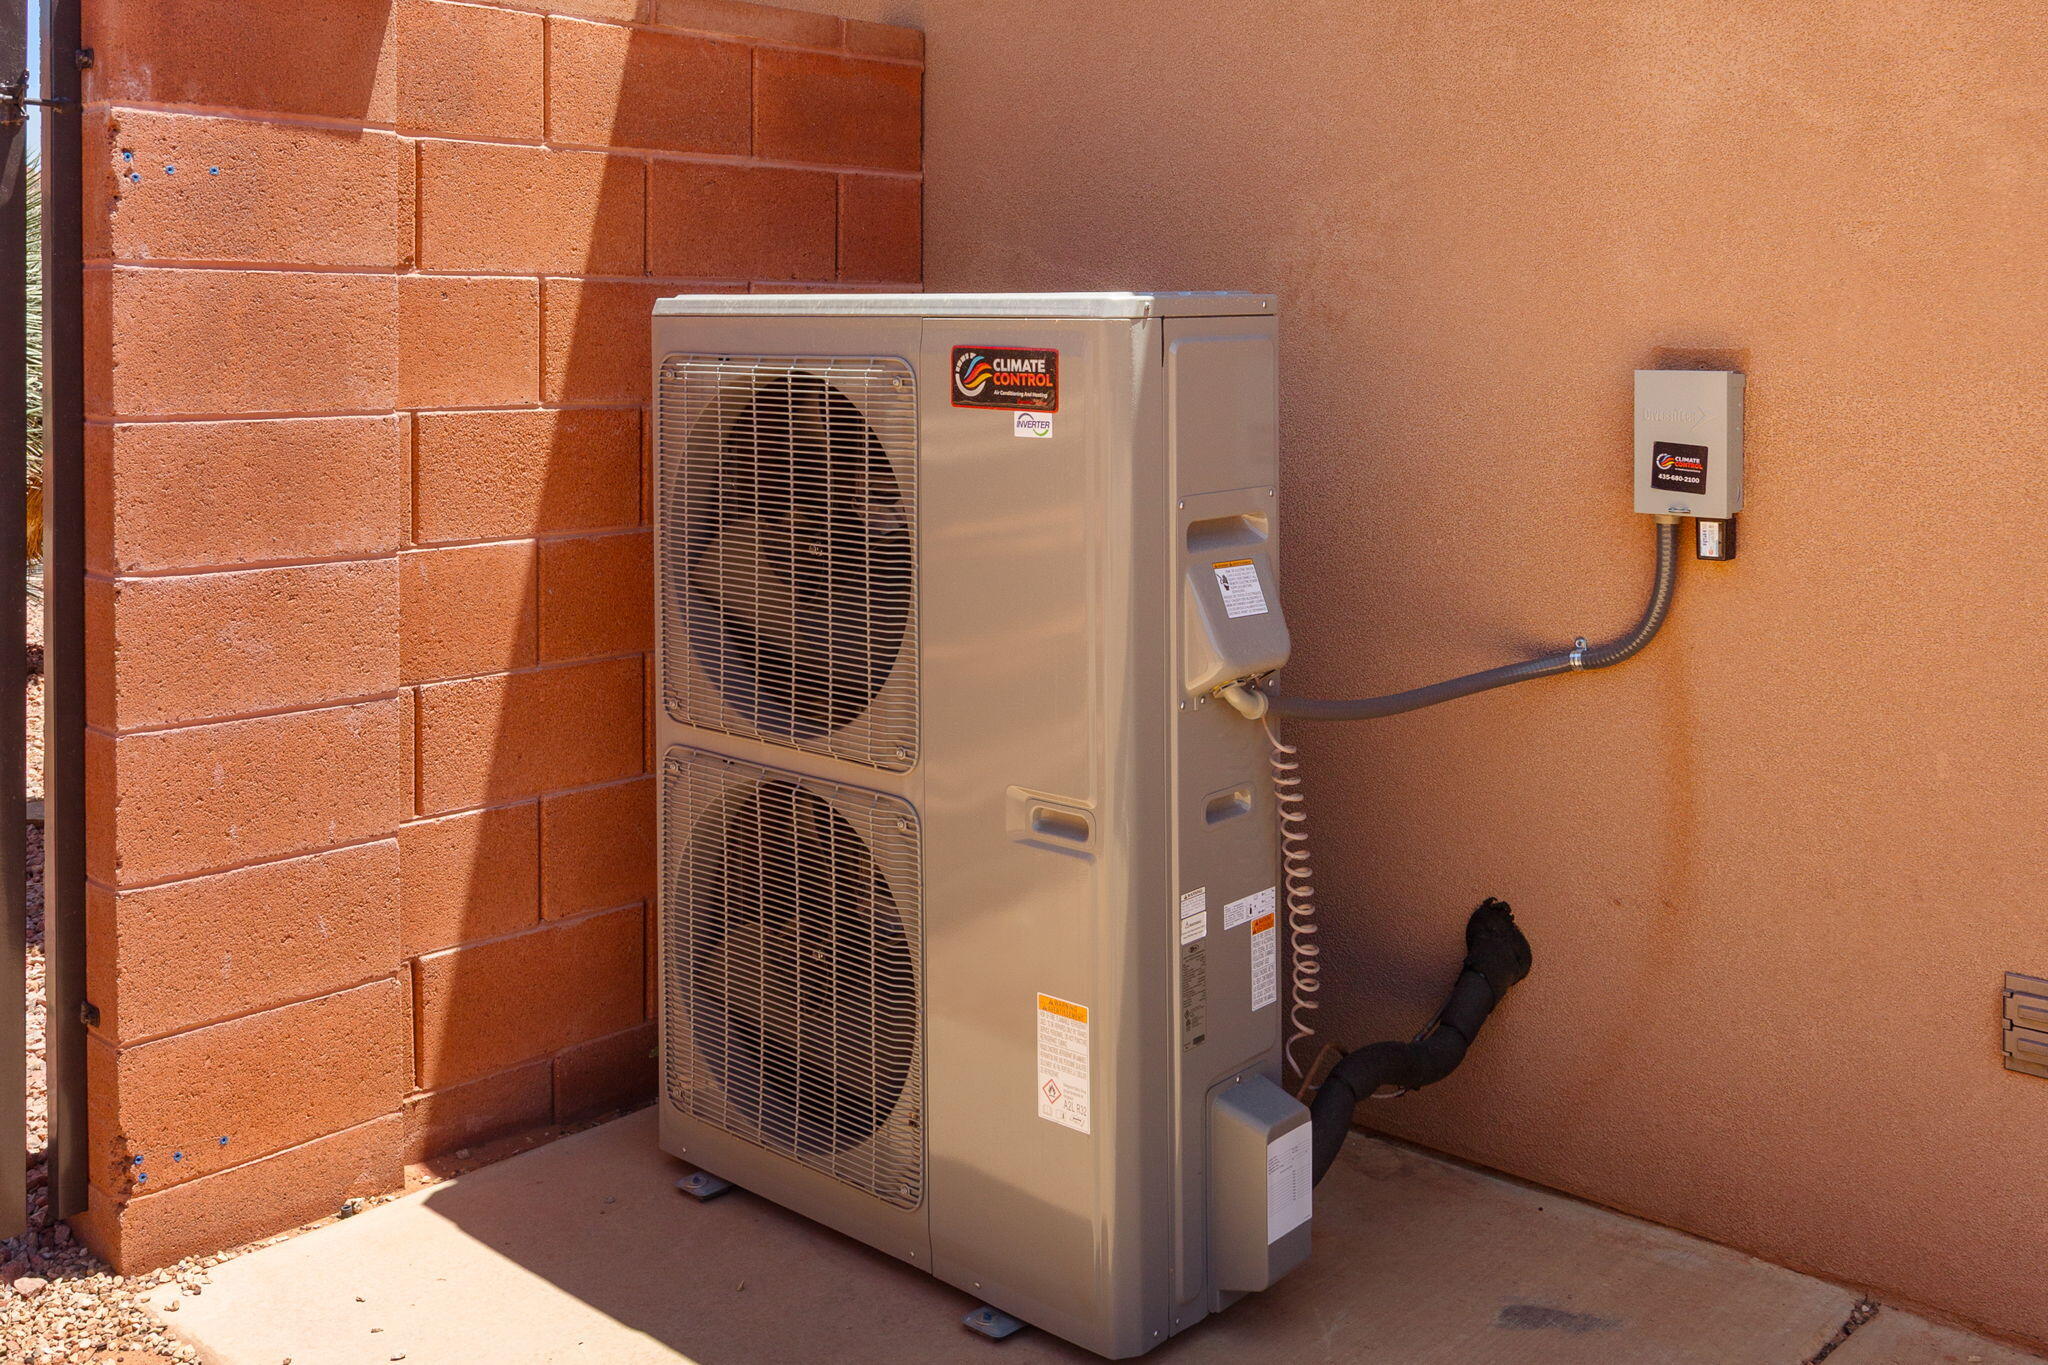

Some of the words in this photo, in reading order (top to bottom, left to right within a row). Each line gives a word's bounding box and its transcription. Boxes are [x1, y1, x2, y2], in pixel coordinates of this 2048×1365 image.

[993, 358, 1046, 373] CLIMATE
[993, 372, 1054, 387] CONTROL
[1016, 420, 1050, 429] INVERTER
[1675, 456, 1700, 464] CLIMATE
